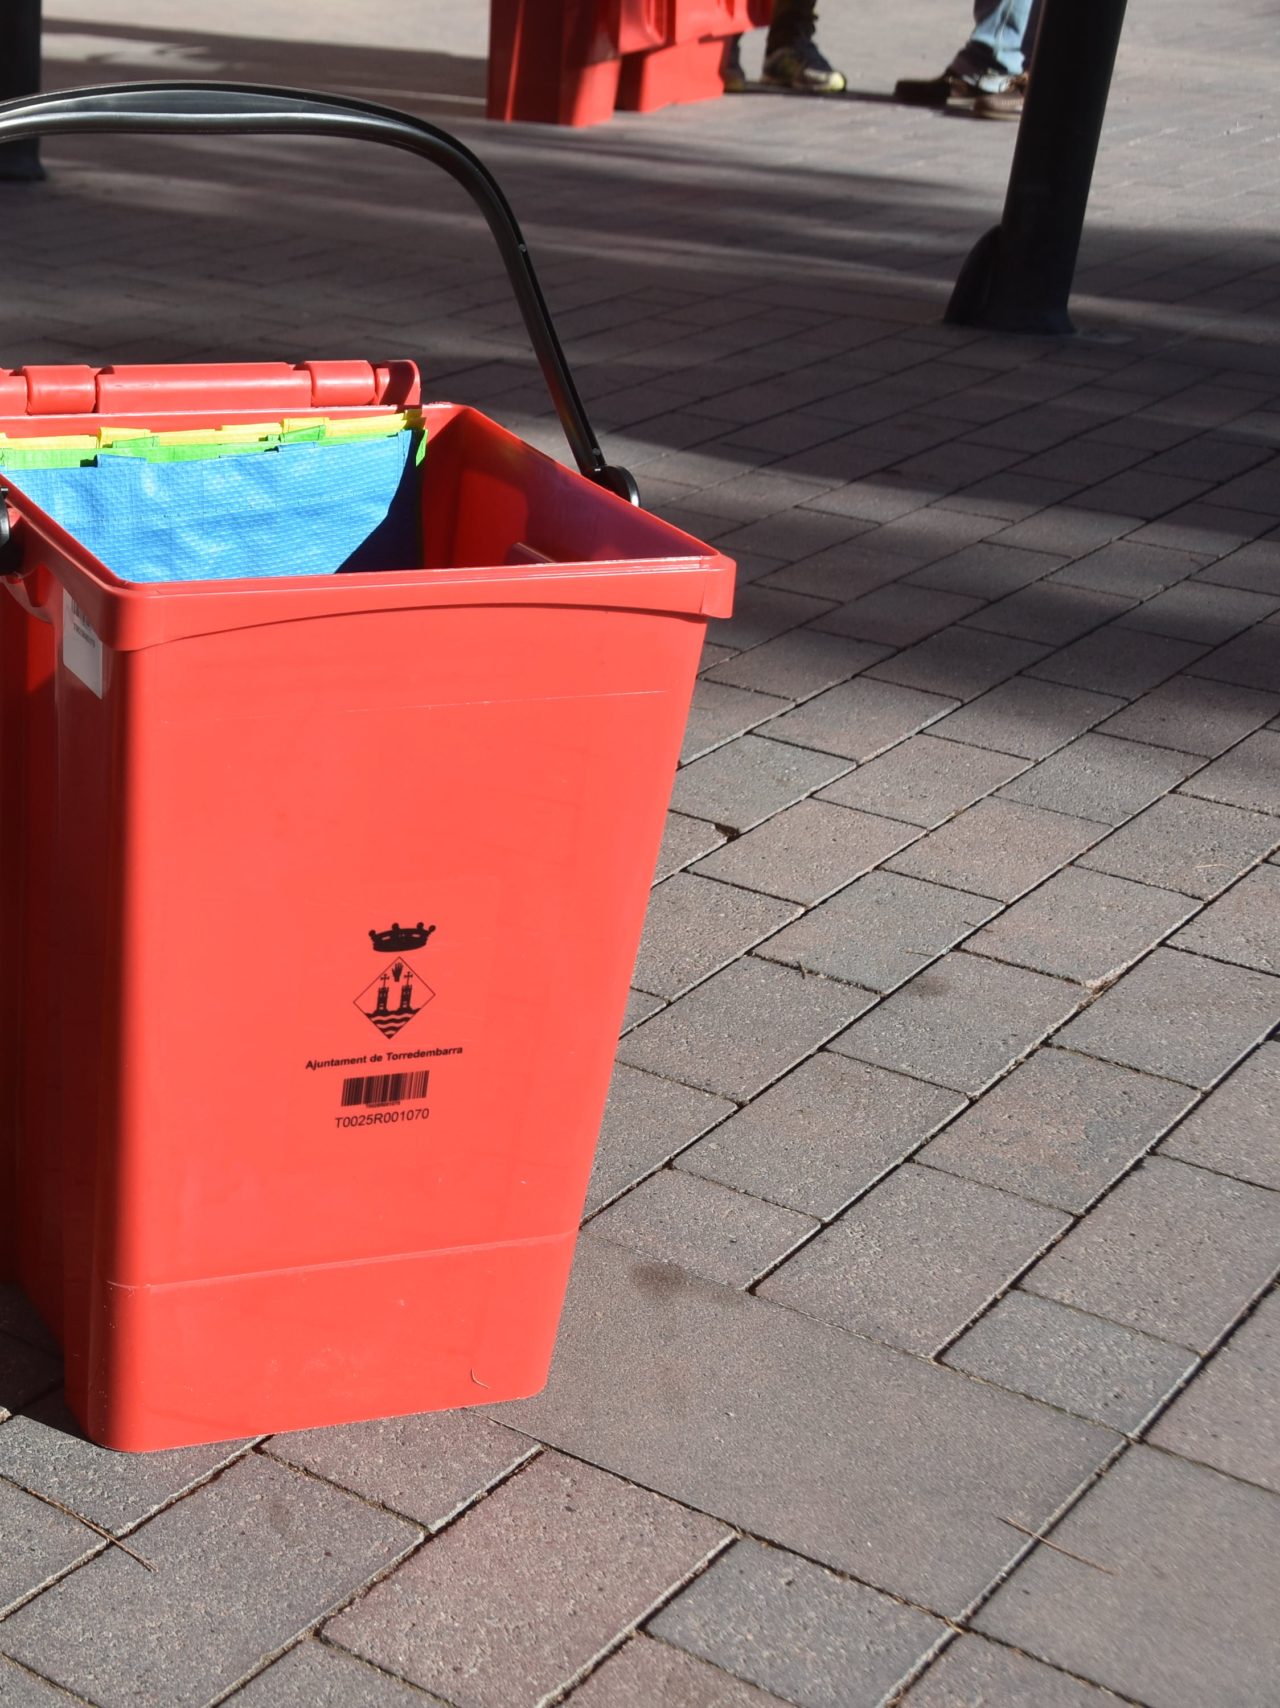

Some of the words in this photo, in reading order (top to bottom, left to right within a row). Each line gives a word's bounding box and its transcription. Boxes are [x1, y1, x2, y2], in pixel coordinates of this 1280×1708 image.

[305, 1056, 367, 1071] Ajuntament
[369, 1053, 383, 1063] de
[386, 1046, 463, 1062] Torredembarra
[335, 1108, 430, 1128] T0025R001070
